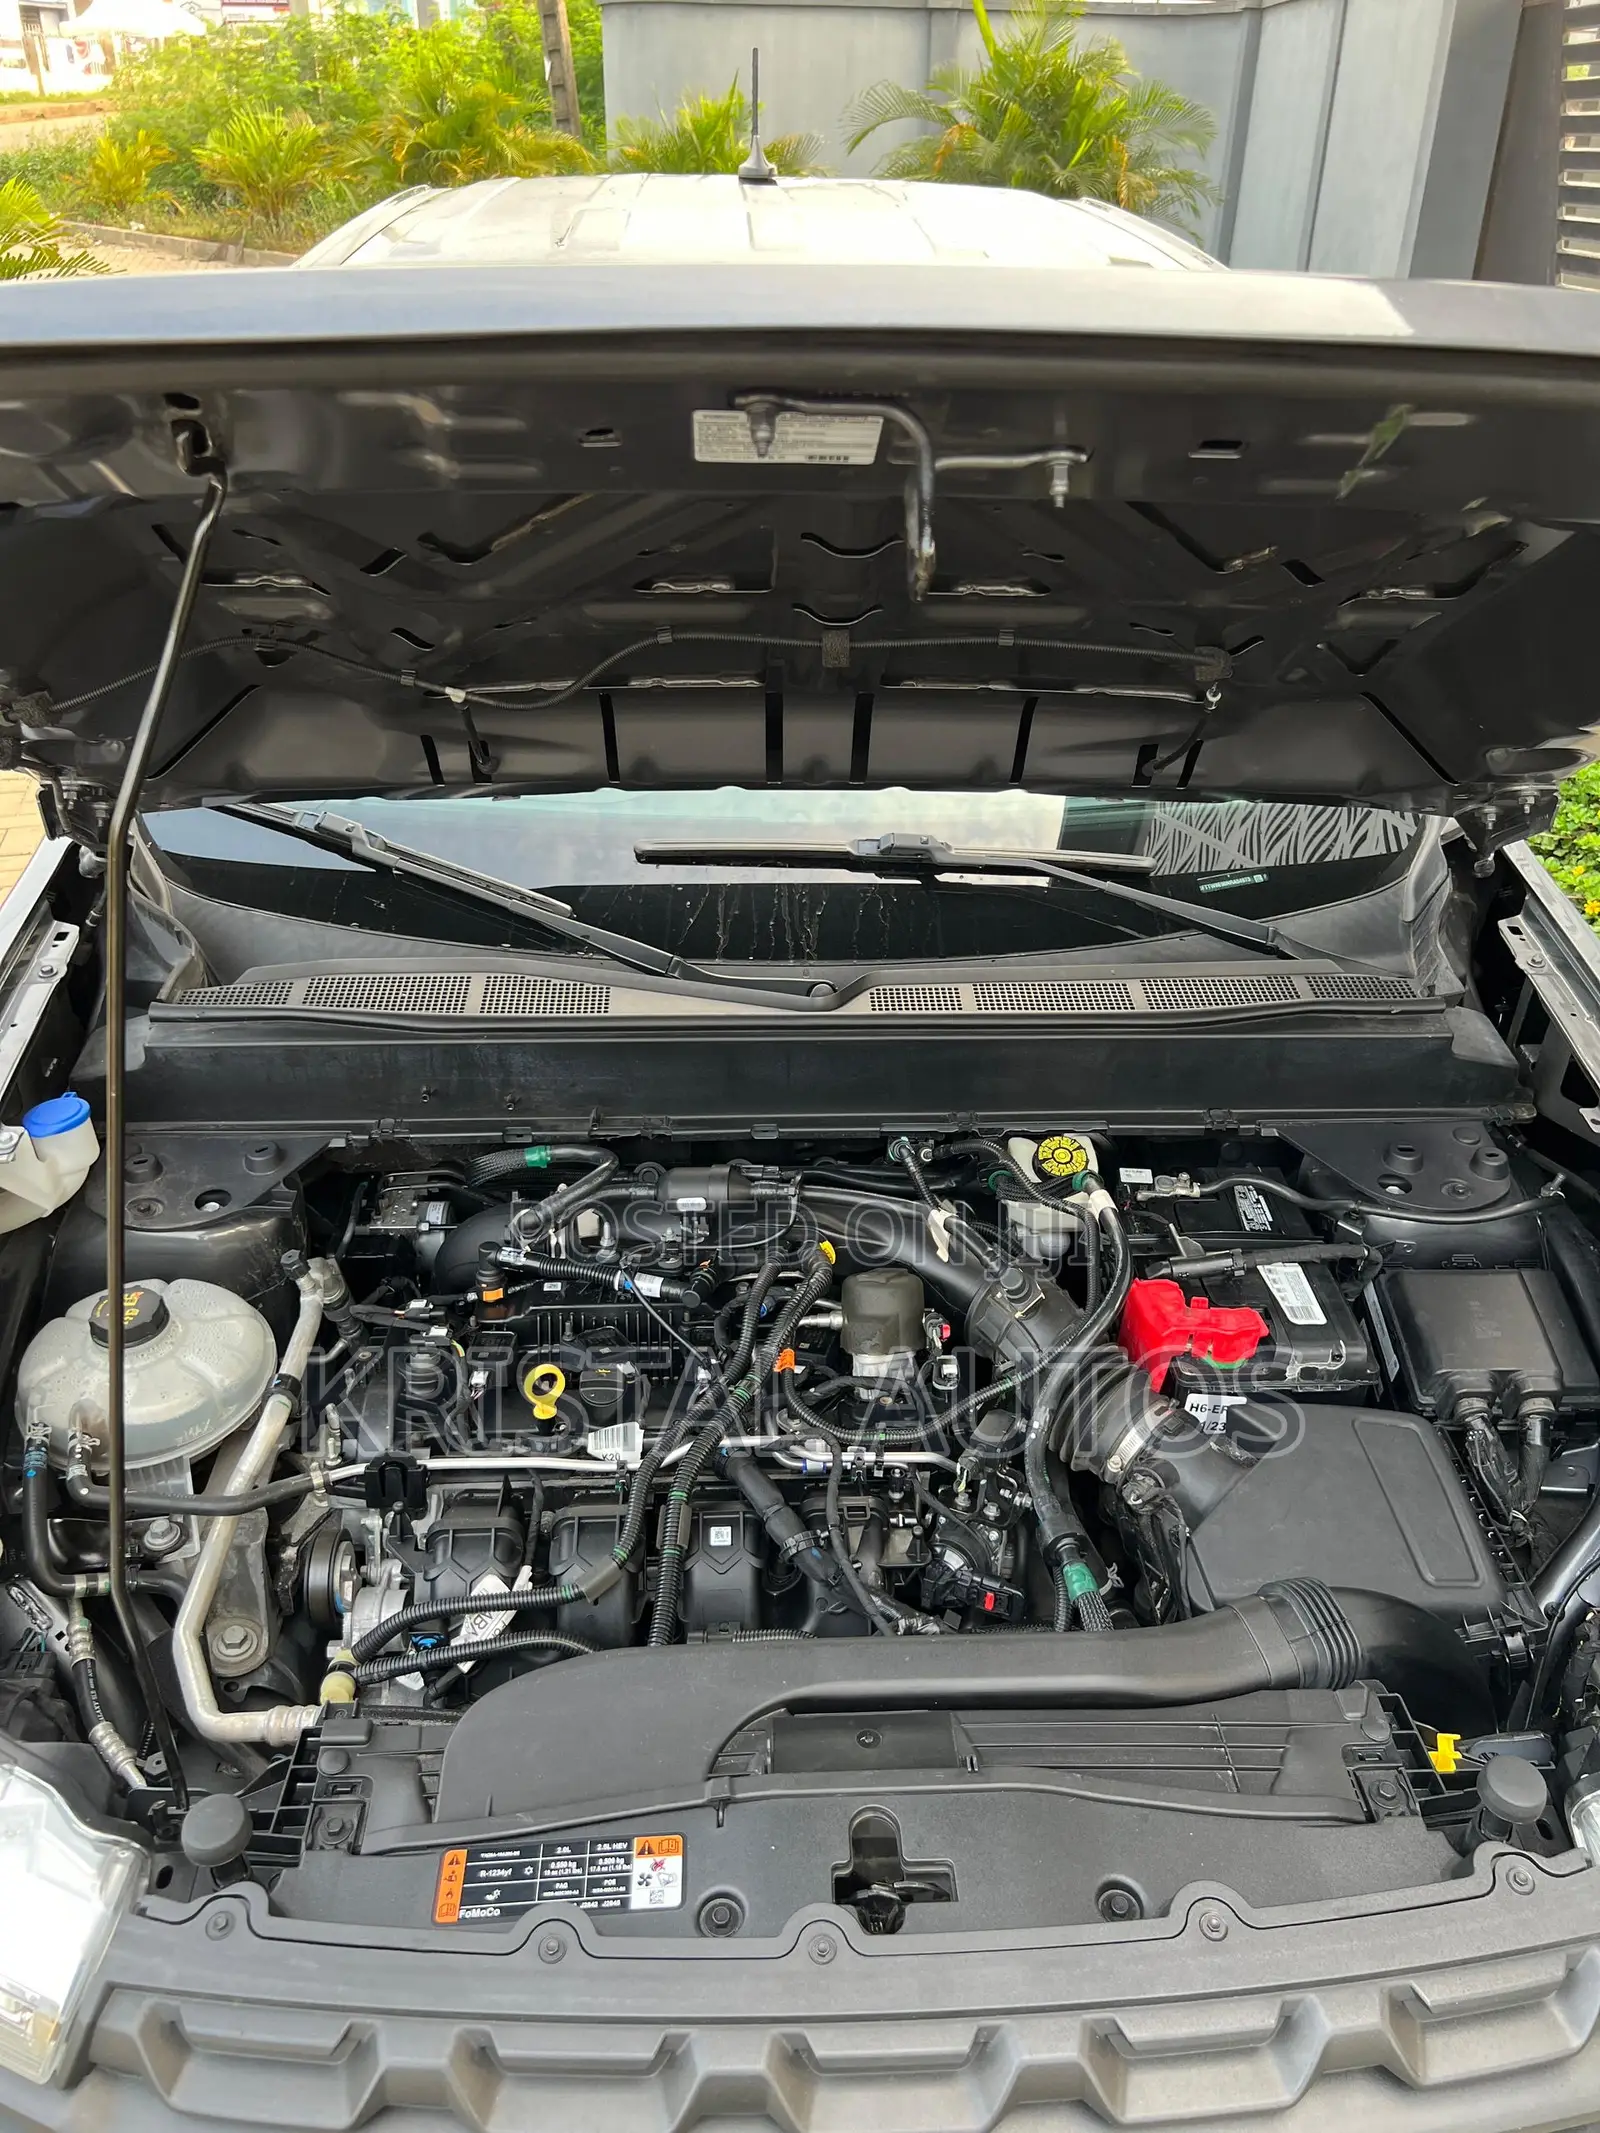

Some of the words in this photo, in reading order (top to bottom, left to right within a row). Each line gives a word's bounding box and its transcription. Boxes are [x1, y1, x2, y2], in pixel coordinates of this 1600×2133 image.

[612, 1841, 628, 1850] HEV
[480, 1868, 512, 1878] R-1234yf
[459, 1908, 501, 1919] FoMoCo
